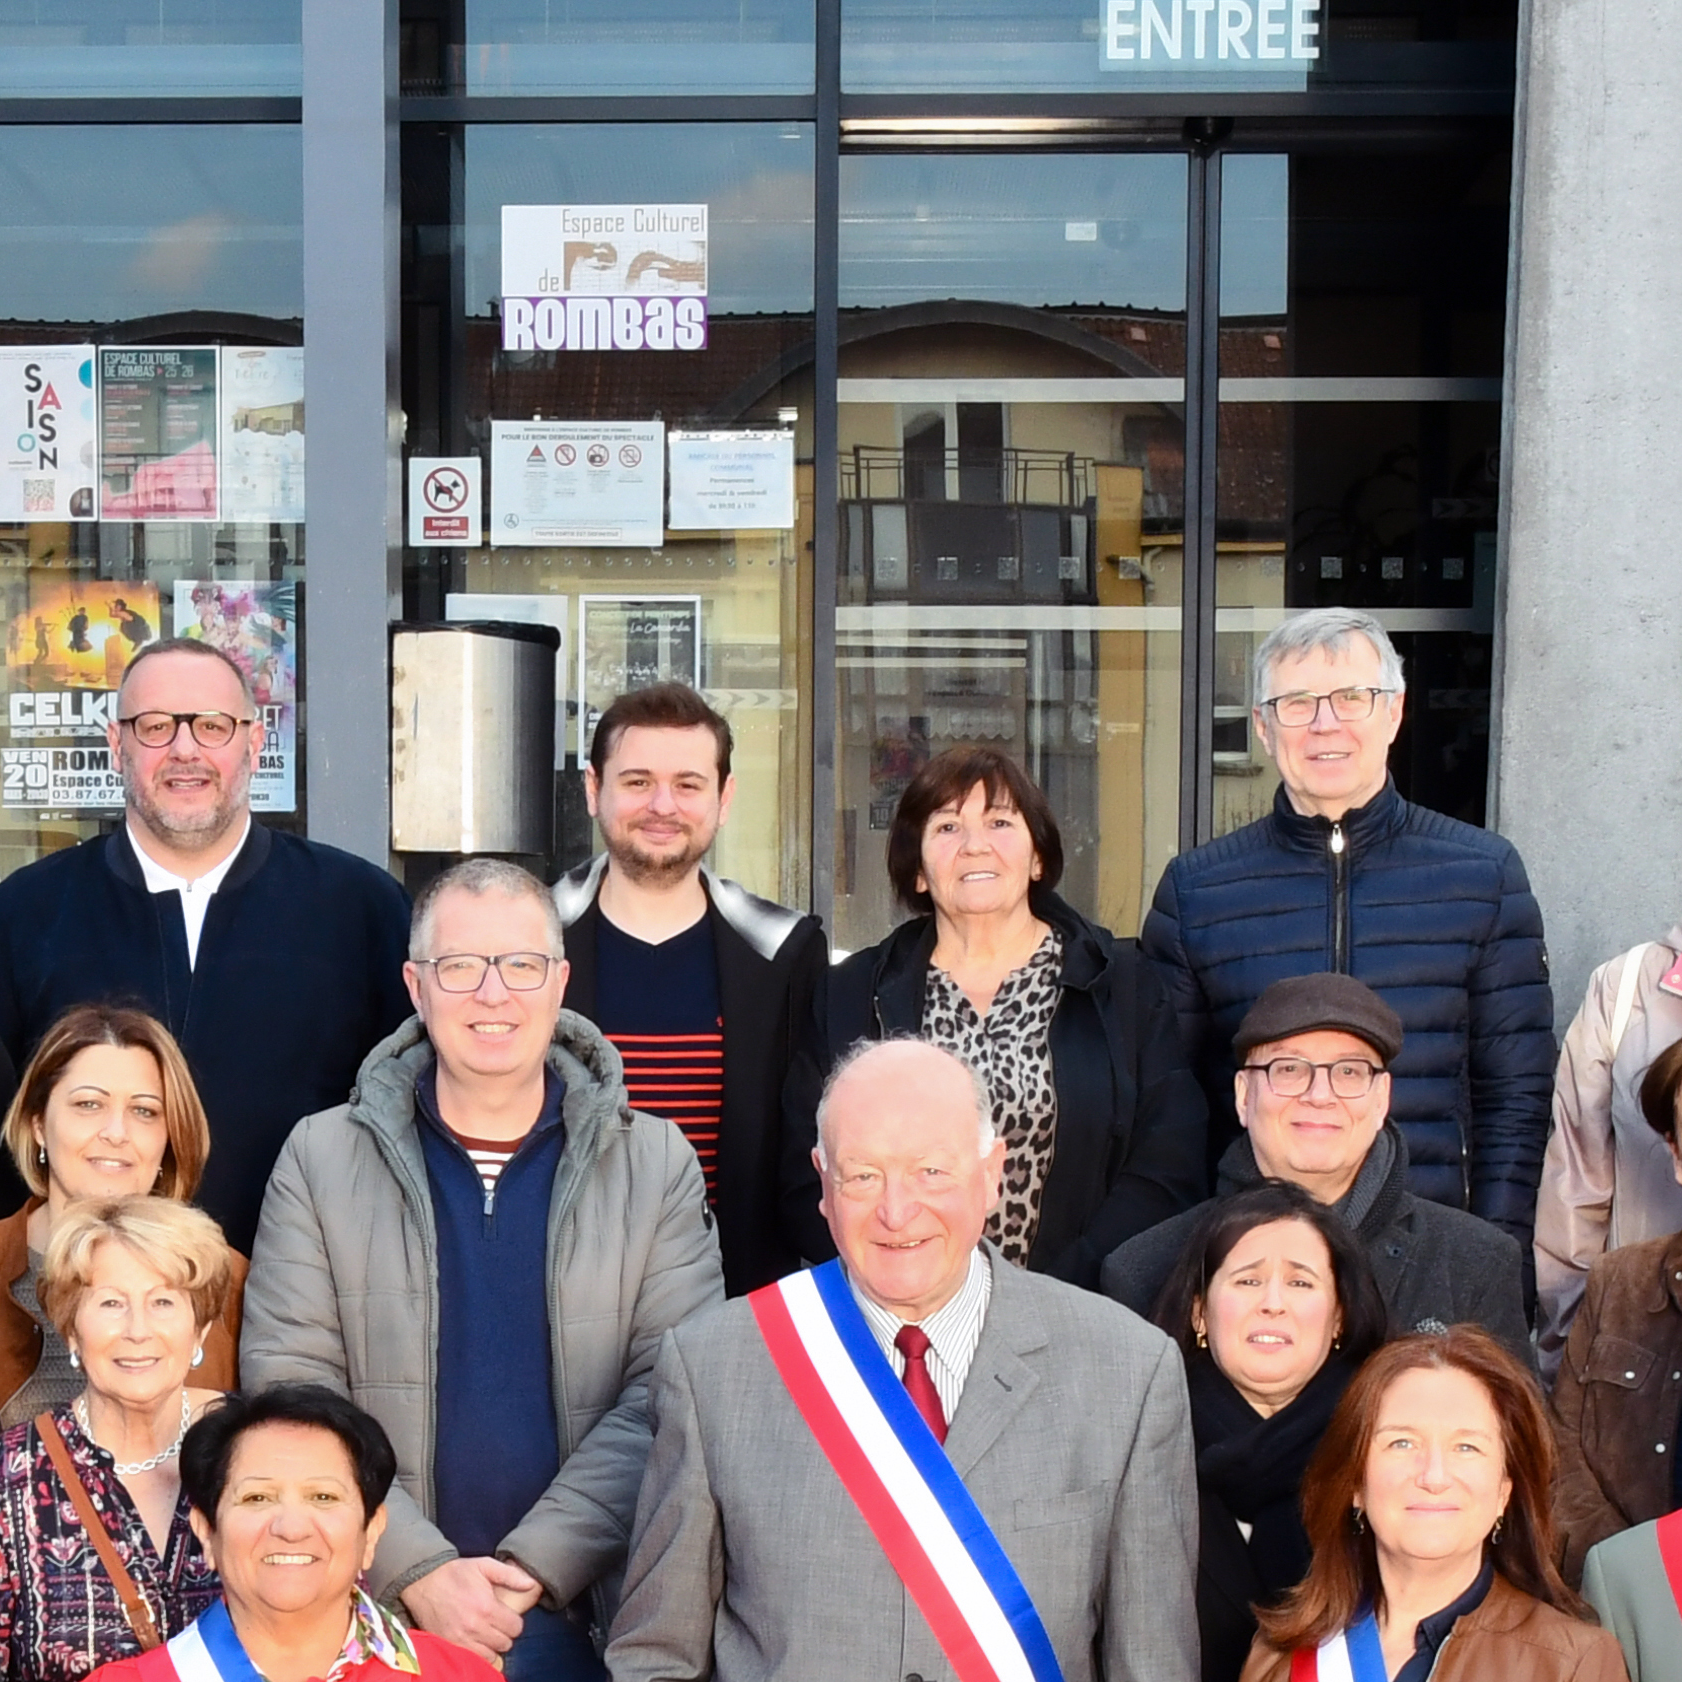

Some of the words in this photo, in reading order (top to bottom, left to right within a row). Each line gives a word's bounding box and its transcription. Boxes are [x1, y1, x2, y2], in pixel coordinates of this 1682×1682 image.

[562, 208, 625, 239] Espace
[634, 207, 705, 233] Culturel
[538, 268, 560, 292] de
[104, 352, 138, 365] ESPACE
[139, 352, 182, 365] CULTUREL
[104, 365, 116, 377] DE
[118, 365, 155, 377] ROMBAS
[2, 751, 47, 763] VEN
[52, 750, 109, 771] ROM
[259, 755, 285, 769] BAS
[3, 763, 48, 788] 20
[53, 774, 102, 788] Espace
[105, 774, 124, 788] Cu
[52, 789, 126, 800] 03.87.67.
